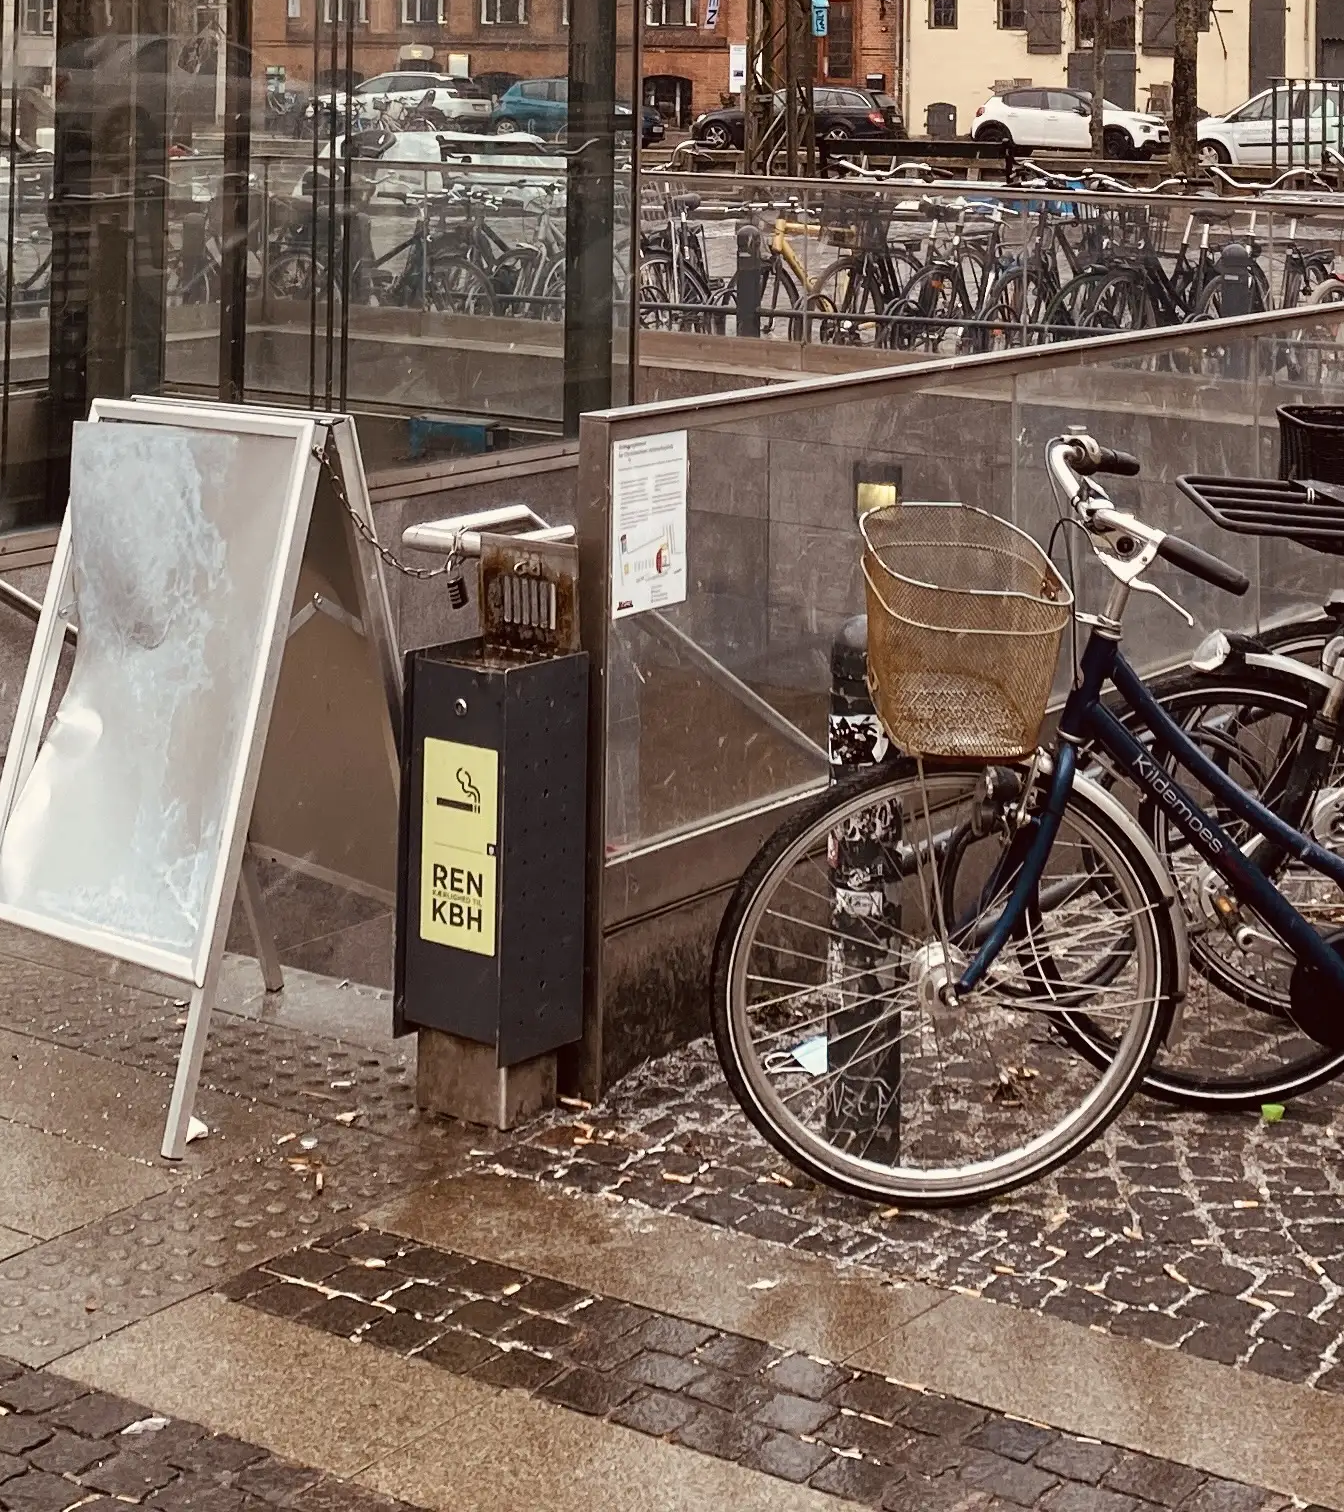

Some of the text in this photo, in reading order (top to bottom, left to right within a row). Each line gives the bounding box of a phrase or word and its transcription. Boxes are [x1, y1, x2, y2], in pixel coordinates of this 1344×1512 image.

[1131, 752, 1223, 854] Kildemoes
[433, 863, 483, 898] REN
[432, 898, 482, 933] KBH
